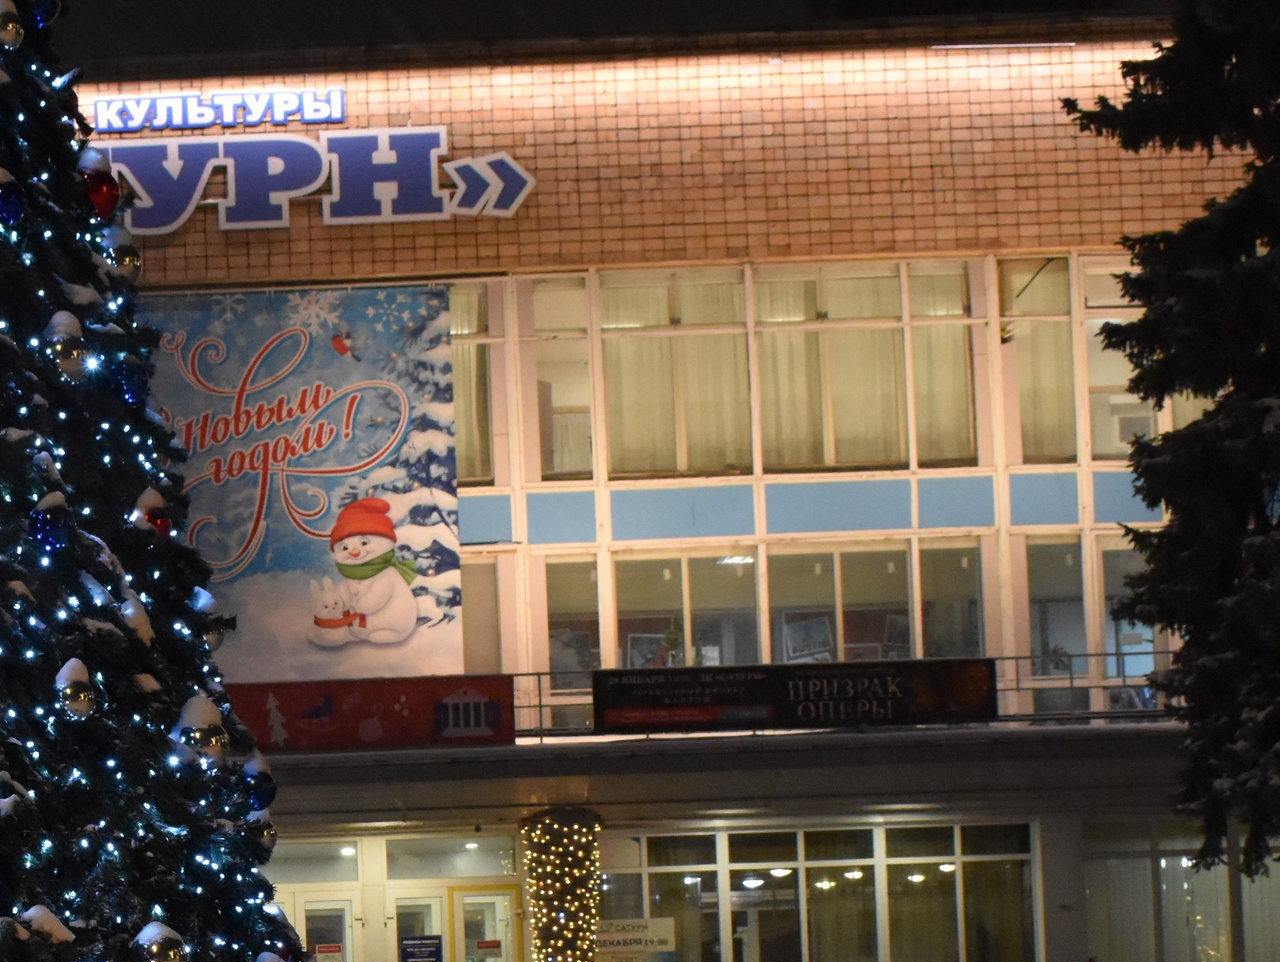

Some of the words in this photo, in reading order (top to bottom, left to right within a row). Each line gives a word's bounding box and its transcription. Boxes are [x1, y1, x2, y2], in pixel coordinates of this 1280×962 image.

[95, 89, 345, 133] КУЛЬТУРЫ
[175, 366, 333, 453] Новым
[788, 677, 903, 700] ПРИЗРАК
[798, 701, 894, 721] ОПЕРЫ
[615, 924, 648, 932] САТУРН
